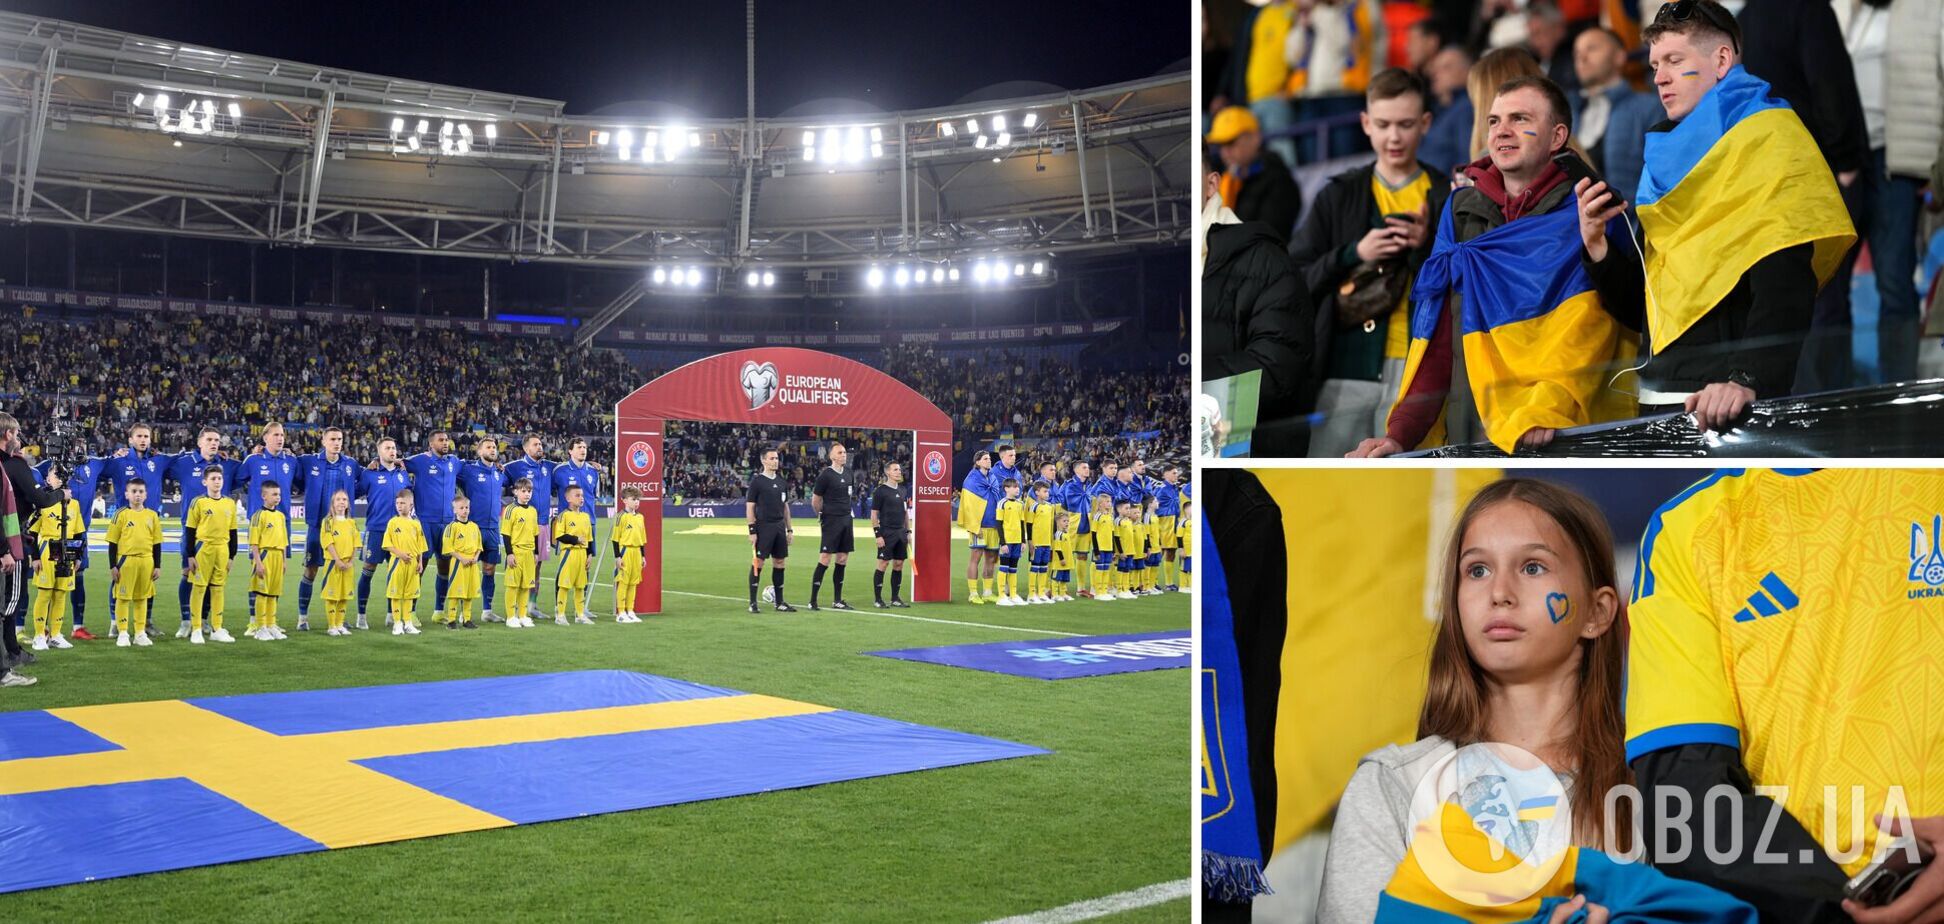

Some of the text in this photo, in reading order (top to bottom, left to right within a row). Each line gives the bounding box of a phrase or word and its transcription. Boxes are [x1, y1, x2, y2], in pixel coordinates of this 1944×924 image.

[786, 374, 841, 390] EUROPEAN
[779, 388, 849, 406] QUALIFIERS
[918, 486, 950, 496] RESPECT
[688, 507, 715, 518] UEFA
[1907, 588, 1944, 599] UKRA
